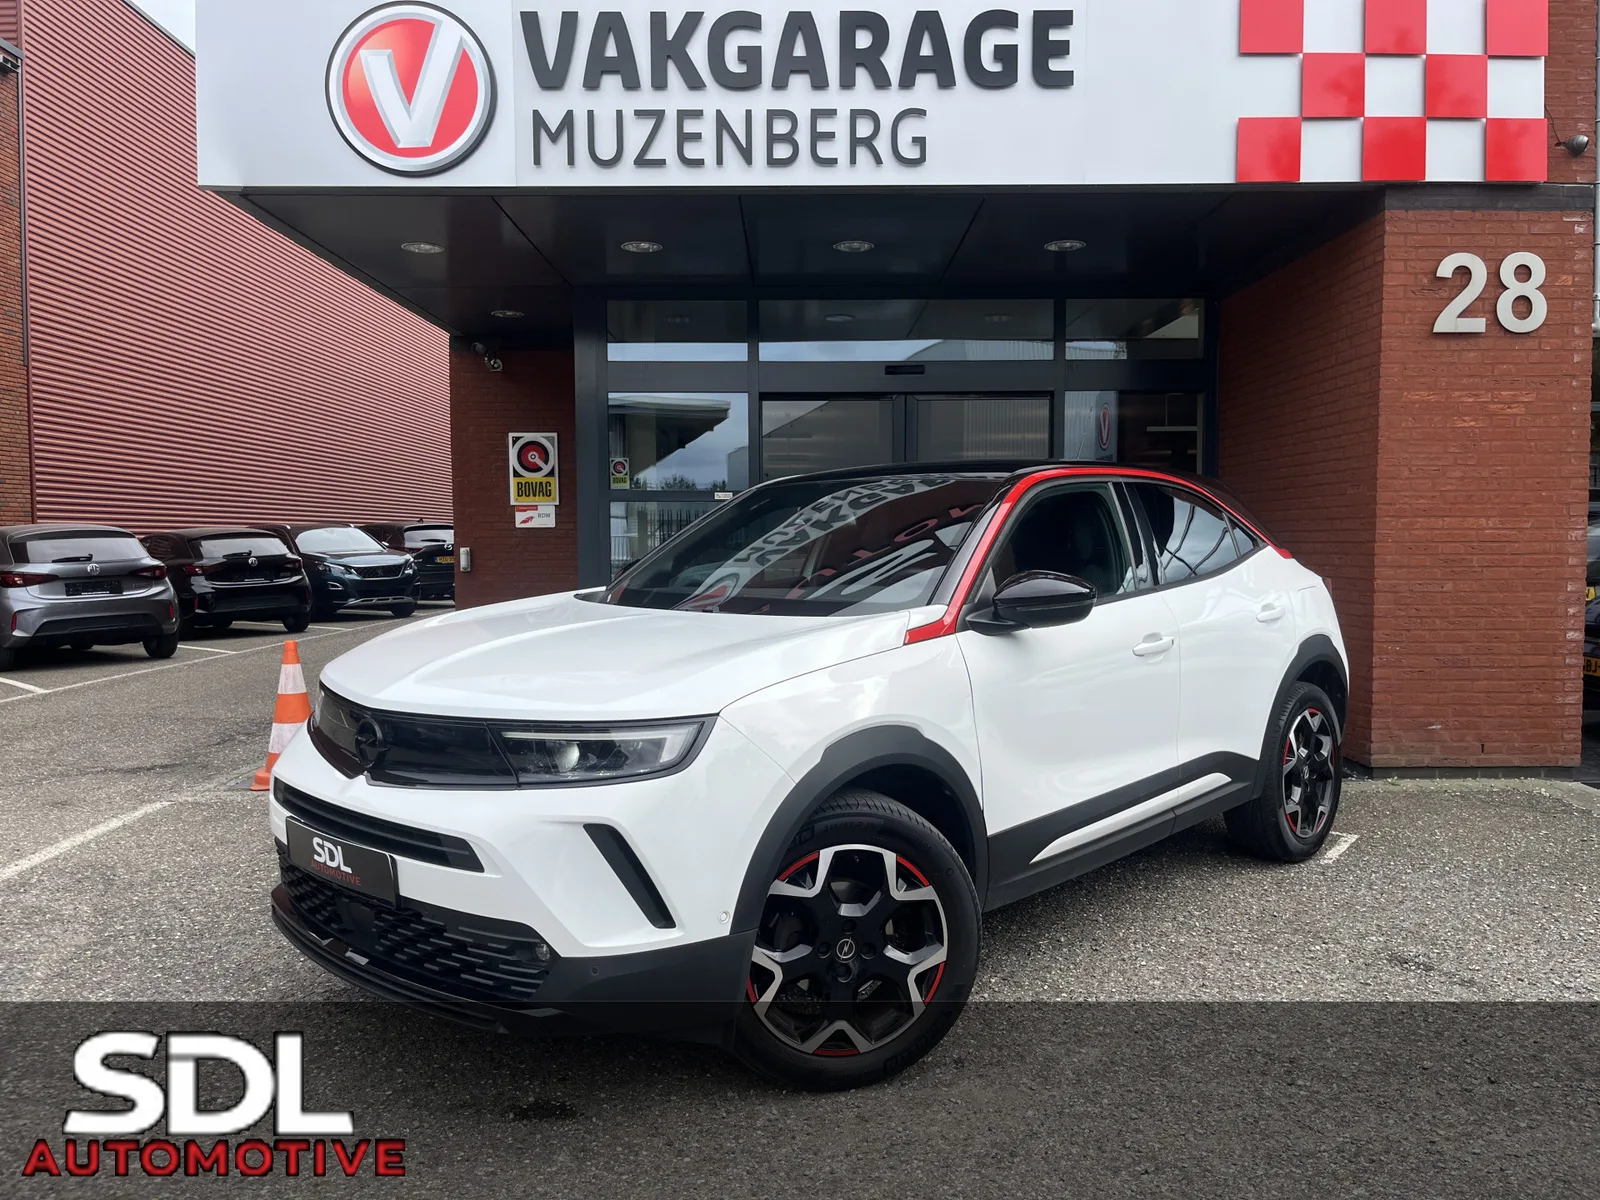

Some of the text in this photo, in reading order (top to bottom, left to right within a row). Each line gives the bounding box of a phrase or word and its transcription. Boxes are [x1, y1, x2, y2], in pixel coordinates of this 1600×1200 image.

[520, 9, 1076, 91] VAKGARAGE
[362, 18, 466, 149] V
[532, 108, 928, 168] MUZENBERG
[1433, 251, 1548, 334] 28
[517, 481, 552, 497] BOVAG
[613, 476, 627, 484] BOVAG
[310, 859, 361, 886] AUTOMOTIVE
[312, 837, 352, 873] SDL
